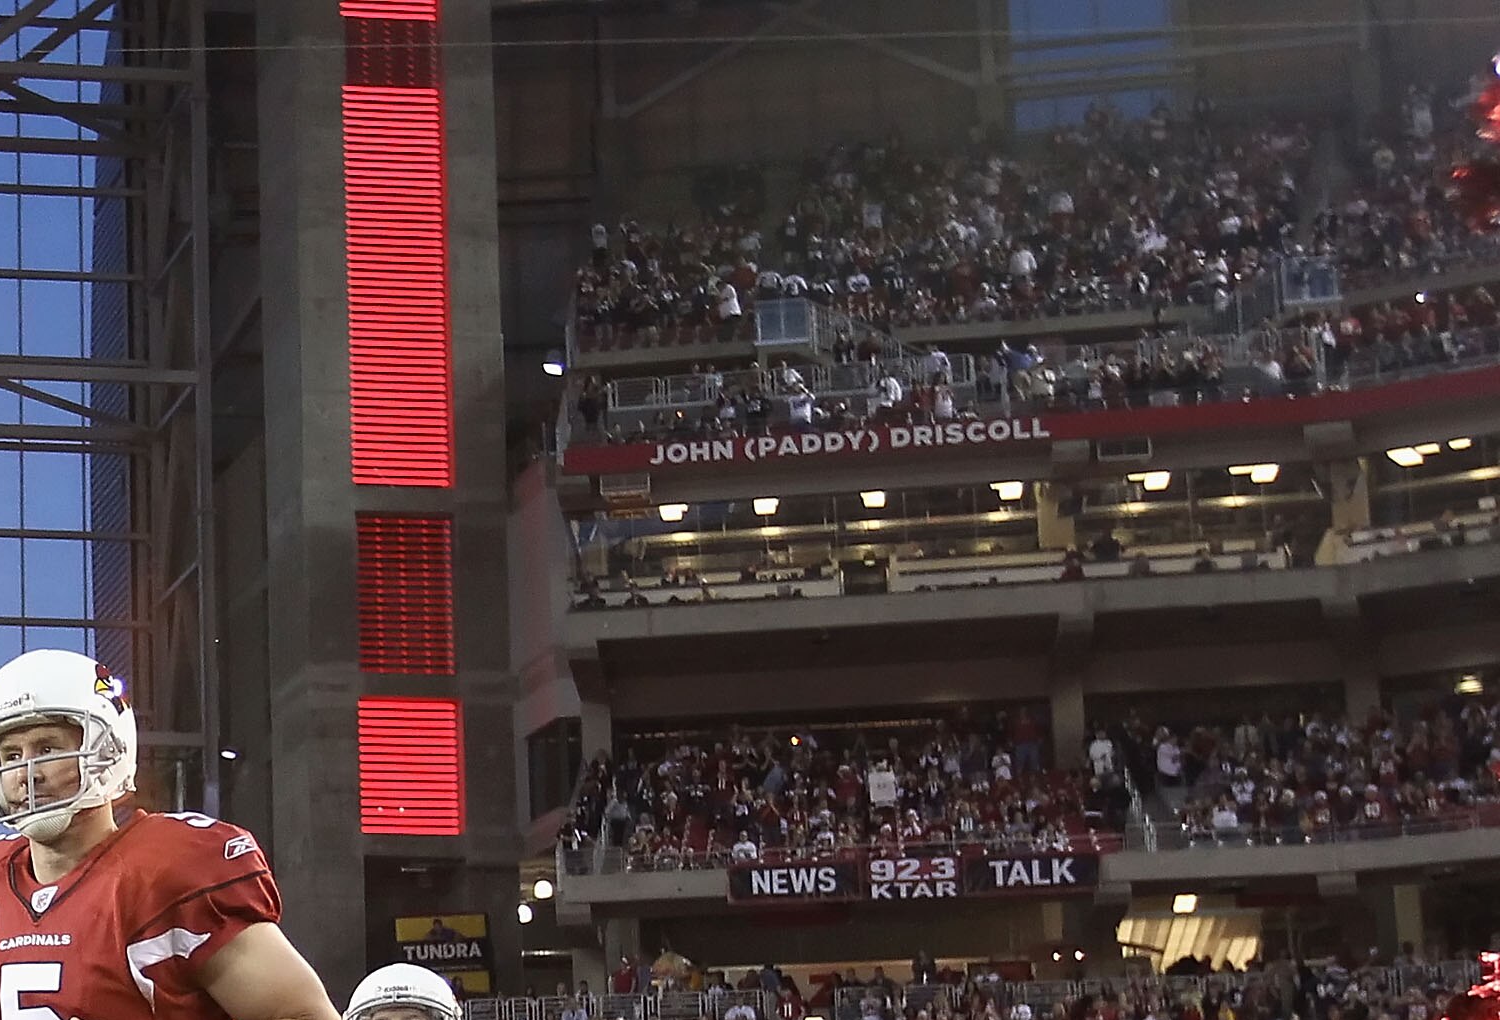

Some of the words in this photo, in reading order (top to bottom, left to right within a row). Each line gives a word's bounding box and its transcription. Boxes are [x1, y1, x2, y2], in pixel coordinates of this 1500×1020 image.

[649, 438, 735, 467] JOHN
[743, 428, 879, 463] (PADDY)
[889, 416, 1052, 449] DRISCOLL
[750, 866, 837, 896] NEWS
[870, 856, 956, 881] 92.3
[988, 856, 1076, 888] TALK
[871, 881, 958, 900] KTAR
[0, 934, 72, 951] CARDINALS
[403, 941, 483, 961] TUNDRA
